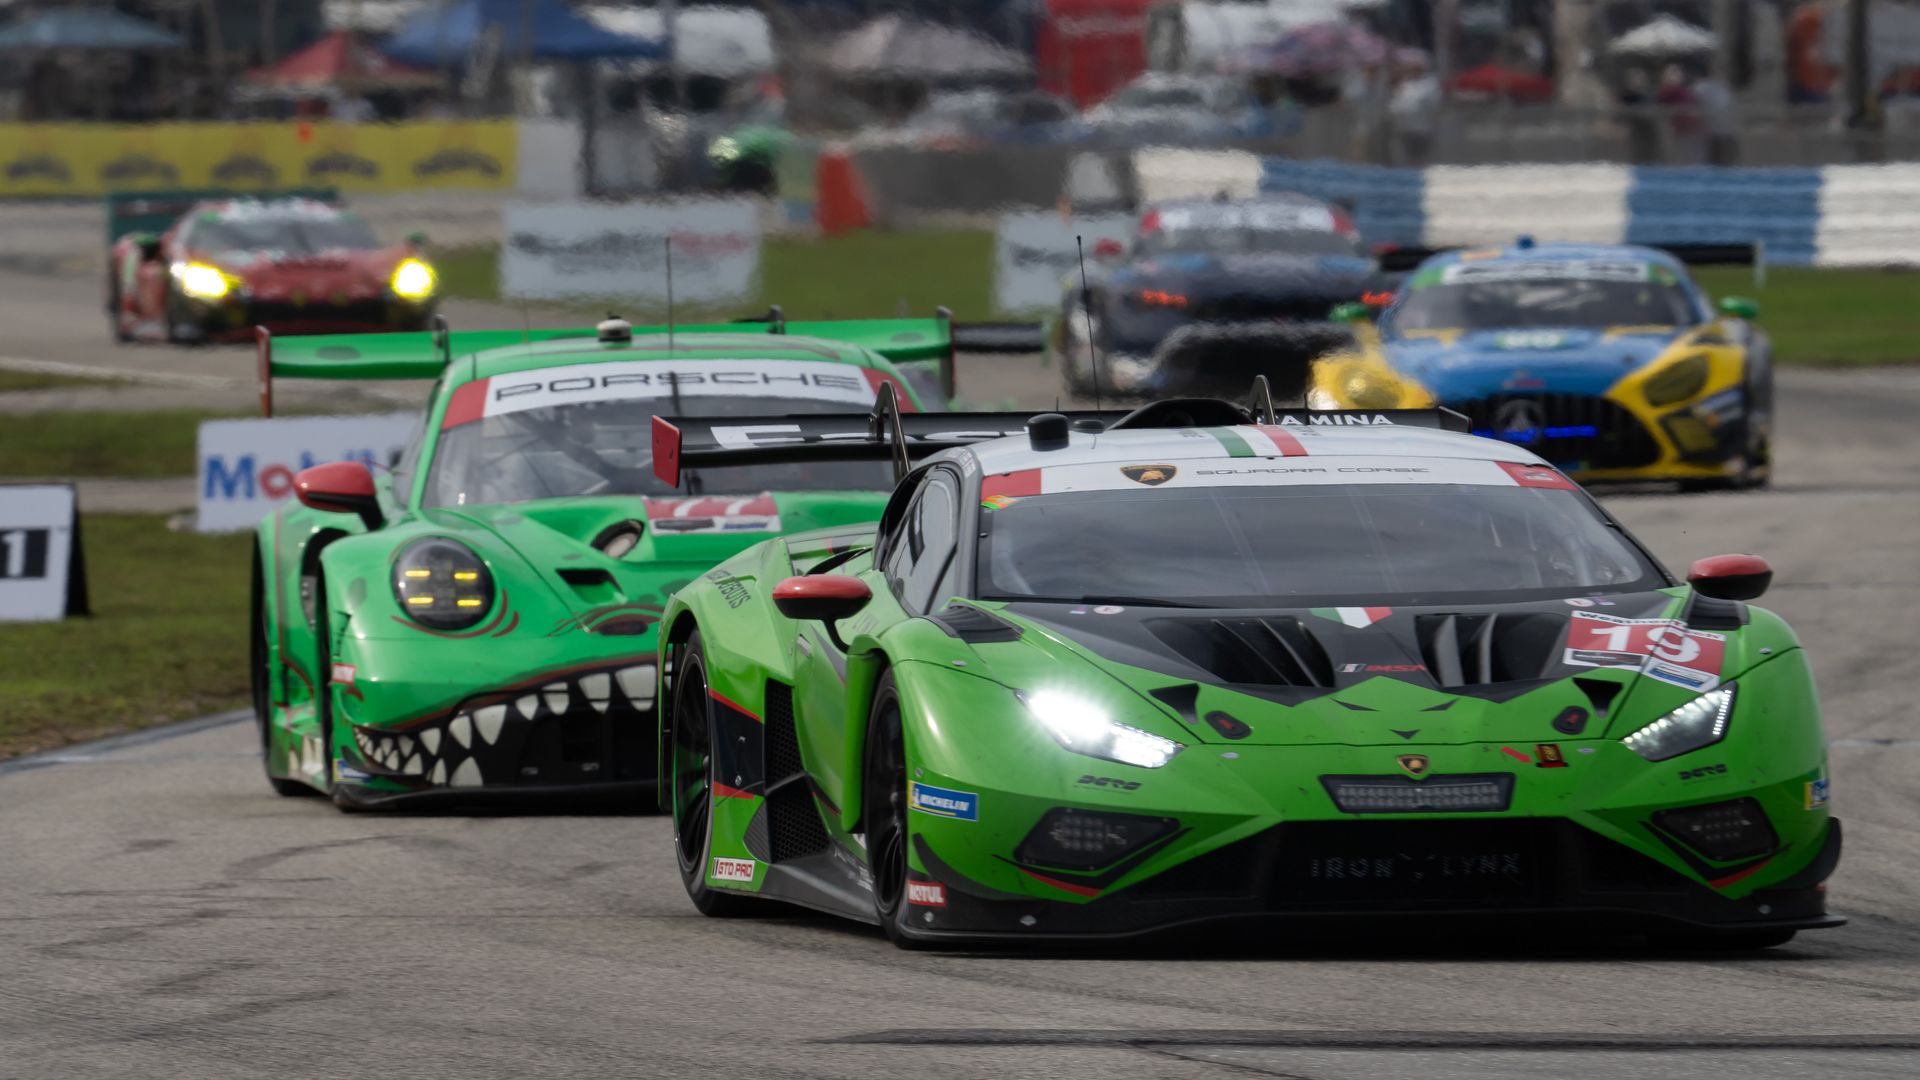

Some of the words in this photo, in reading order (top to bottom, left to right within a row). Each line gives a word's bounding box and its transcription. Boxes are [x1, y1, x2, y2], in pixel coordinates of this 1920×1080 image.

[495, 371, 862, 402] PORSCHE
[1196, 467, 1327, 475] SQUADRA
[1337, 466, 1429, 474] CORSE
[1589, 626, 1701, 663] 19
[919, 793, 970, 812] MICHELIN
[735, 863, 753, 878] PRO
[1311, 857, 1396, 879] IRON
[909, 883, 944, 903] MOTUL
